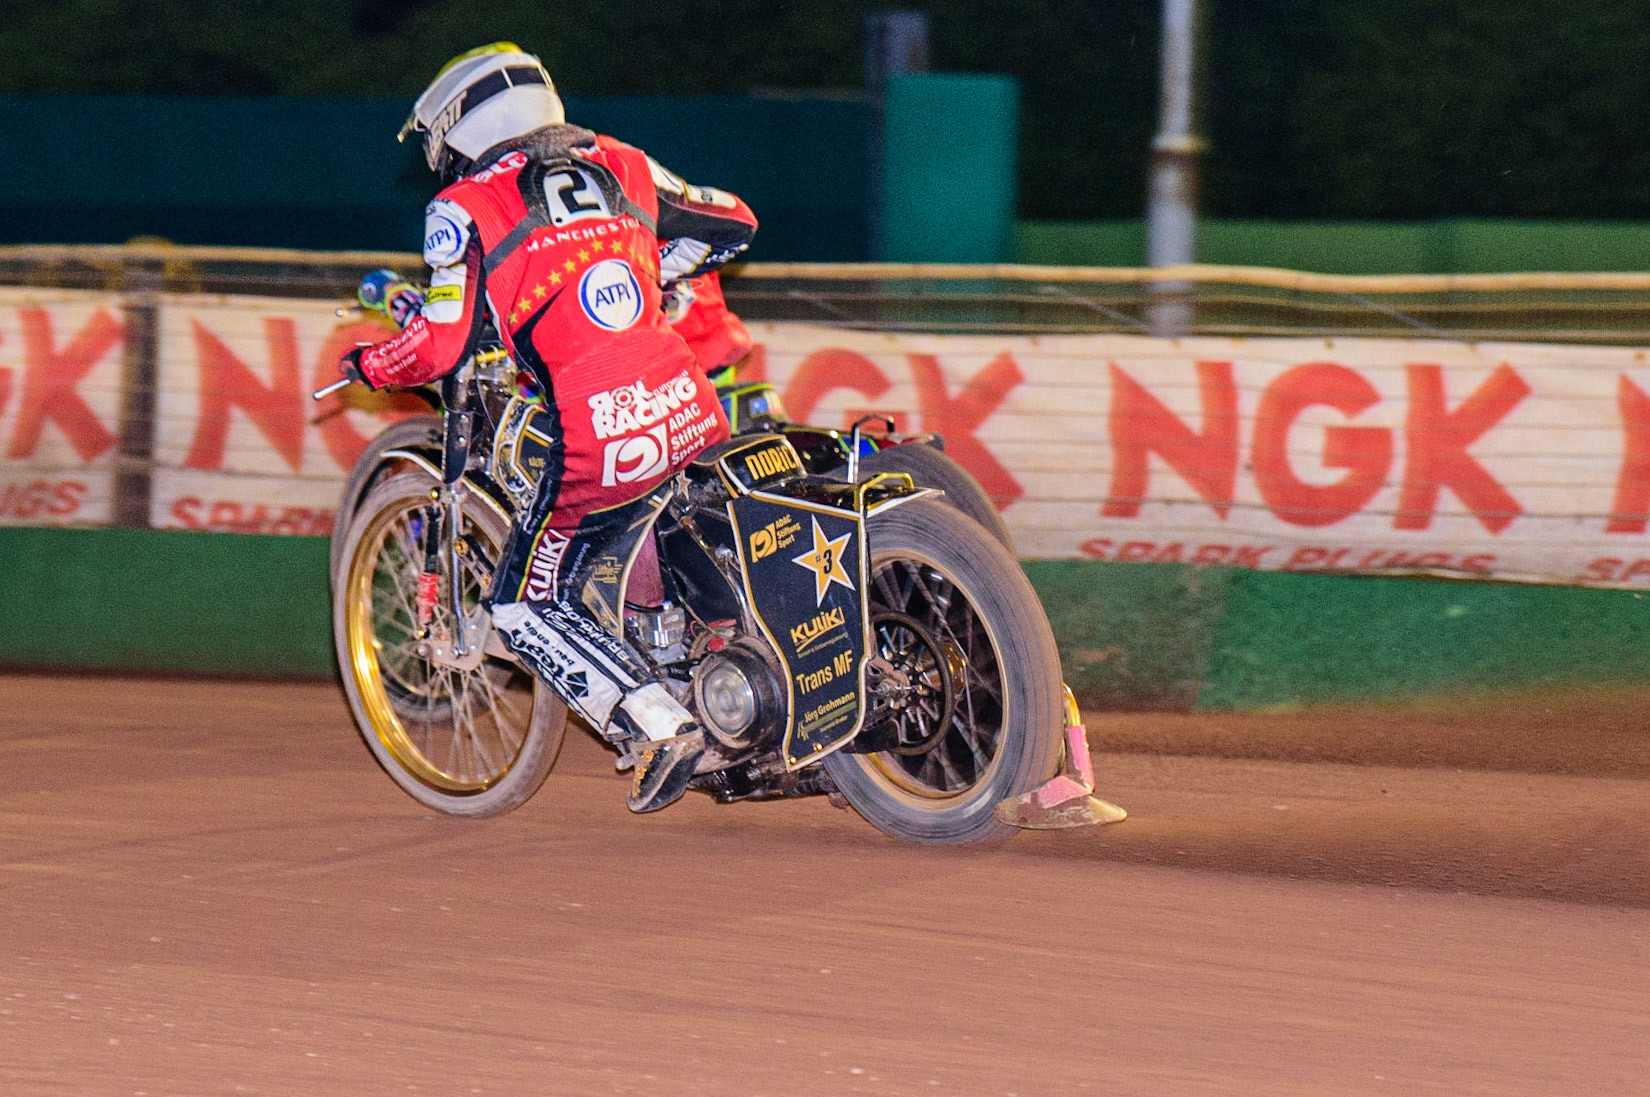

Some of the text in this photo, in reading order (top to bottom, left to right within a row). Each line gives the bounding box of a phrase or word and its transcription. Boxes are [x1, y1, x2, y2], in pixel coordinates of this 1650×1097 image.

[558, 169, 602, 215] 2
[595, 282, 632, 308] ATPI
[590, 376, 698, 440] RACING
[668, 402, 701, 433] ADAC
[670, 412, 718, 451] Stiftung
[750, 343, 1027, 514] GK
[671, 435, 706, 466] Sport
[1101, 360, 1533, 537] NGK
[775, 513, 793, 530] ADAC
[796, 649, 853, 695] Trans MF
[817, 691, 856, 716] Grohmann
